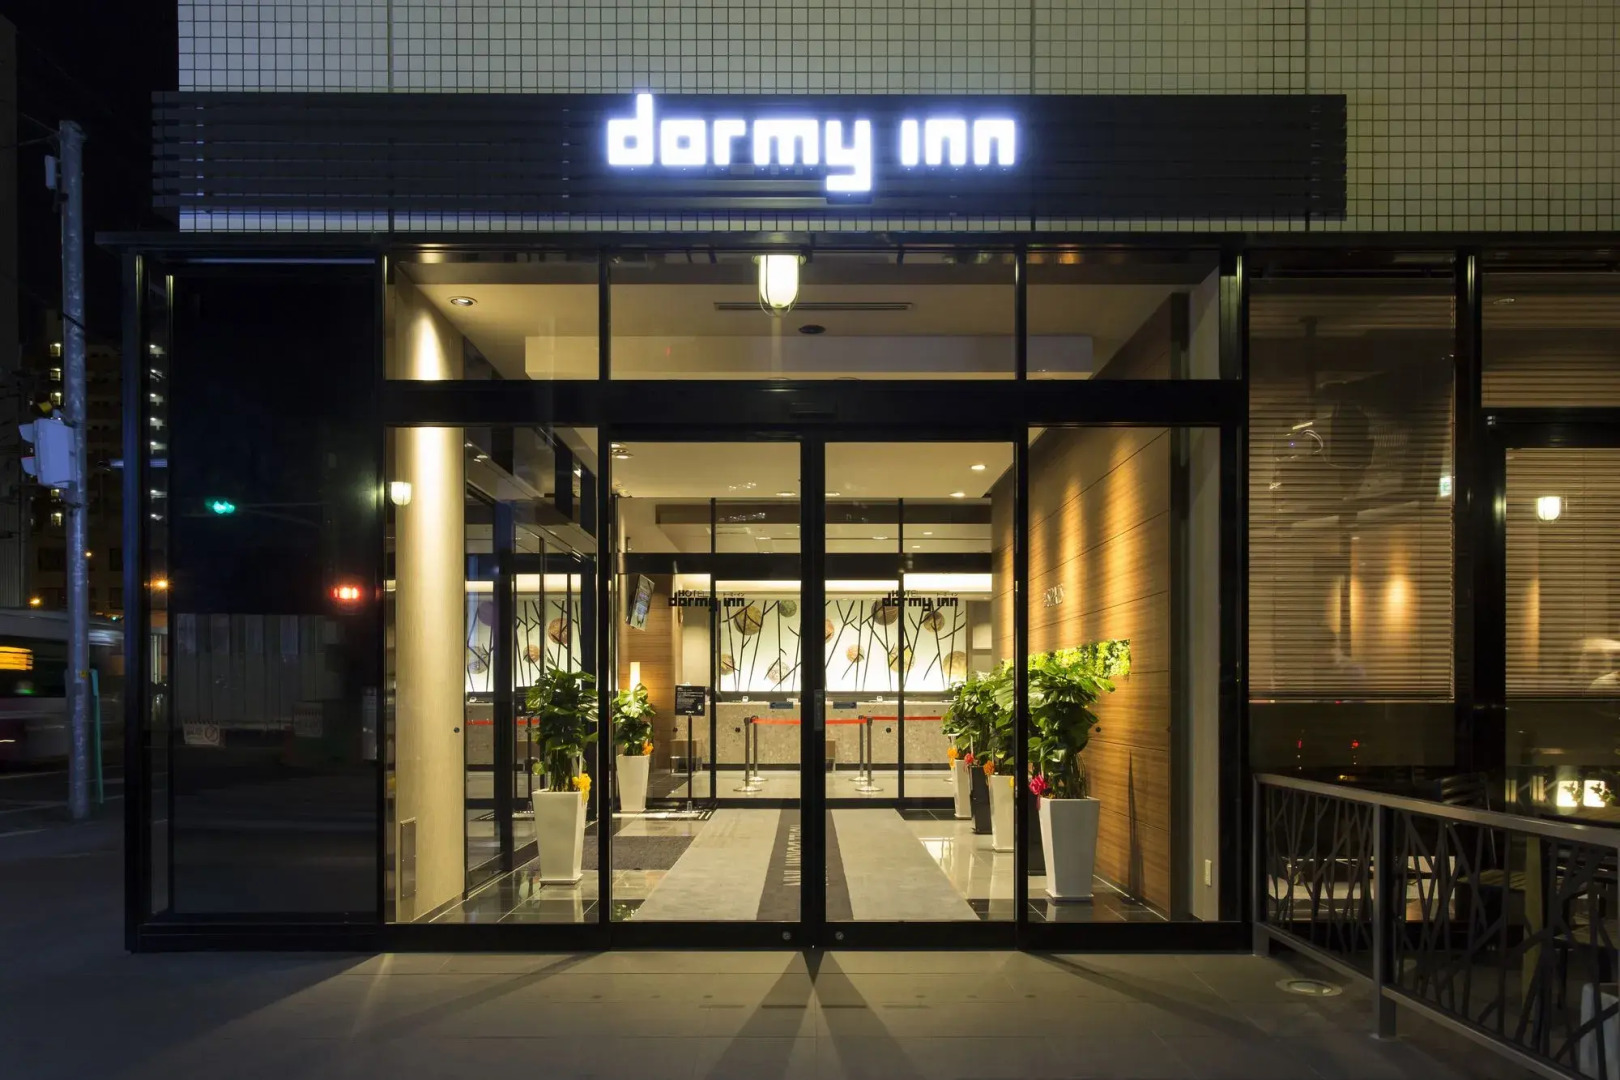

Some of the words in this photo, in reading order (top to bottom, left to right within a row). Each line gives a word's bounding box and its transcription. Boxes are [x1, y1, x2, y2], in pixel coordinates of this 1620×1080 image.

[608, 94, 871, 191] dormy
[902, 119, 1015, 165] inn
[723, 598, 745, 607] inn
[937, 598, 958, 607] inn
